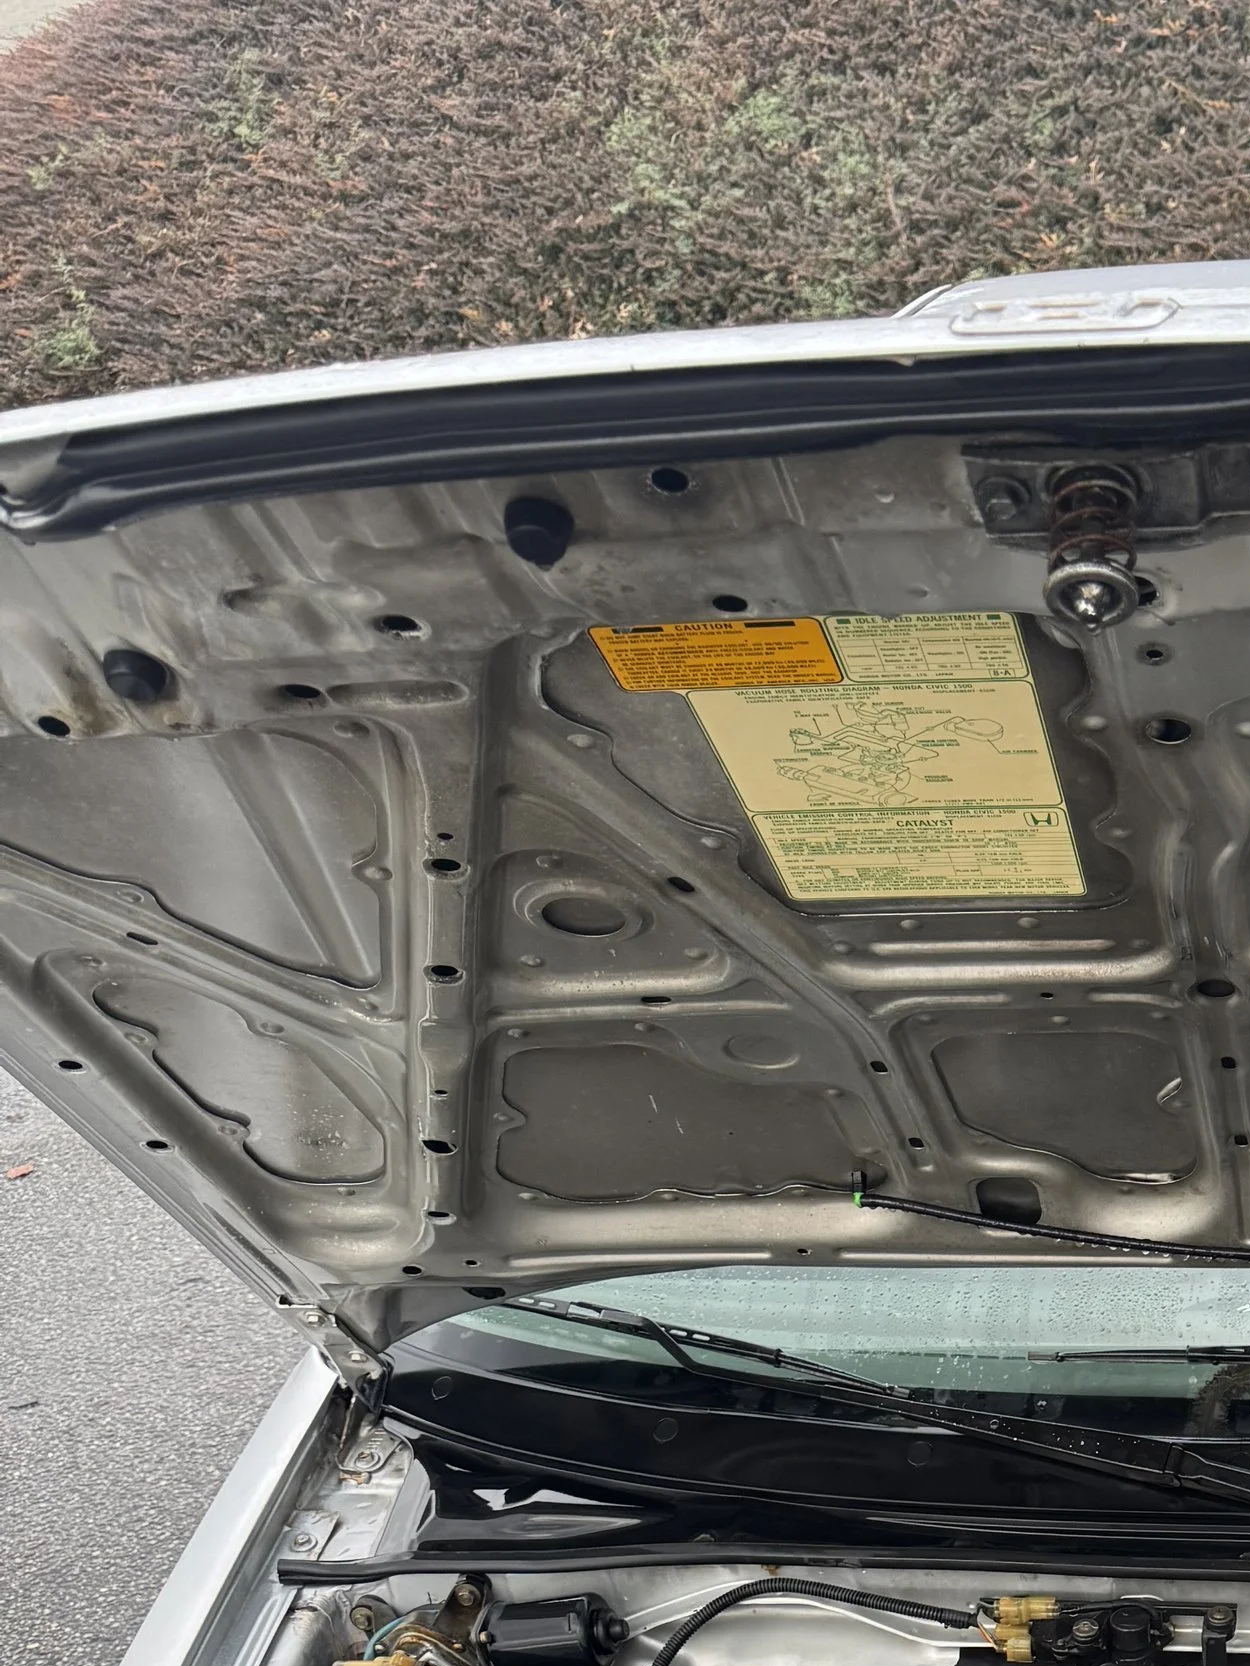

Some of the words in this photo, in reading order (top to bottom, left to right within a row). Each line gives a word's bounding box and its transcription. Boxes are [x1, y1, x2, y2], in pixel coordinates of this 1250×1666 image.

[916, 614, 982, 623] ADJUSTMENT
[674, 623, 734, 632] CAUTION
[896, 820, 954, 828] CATALYST
